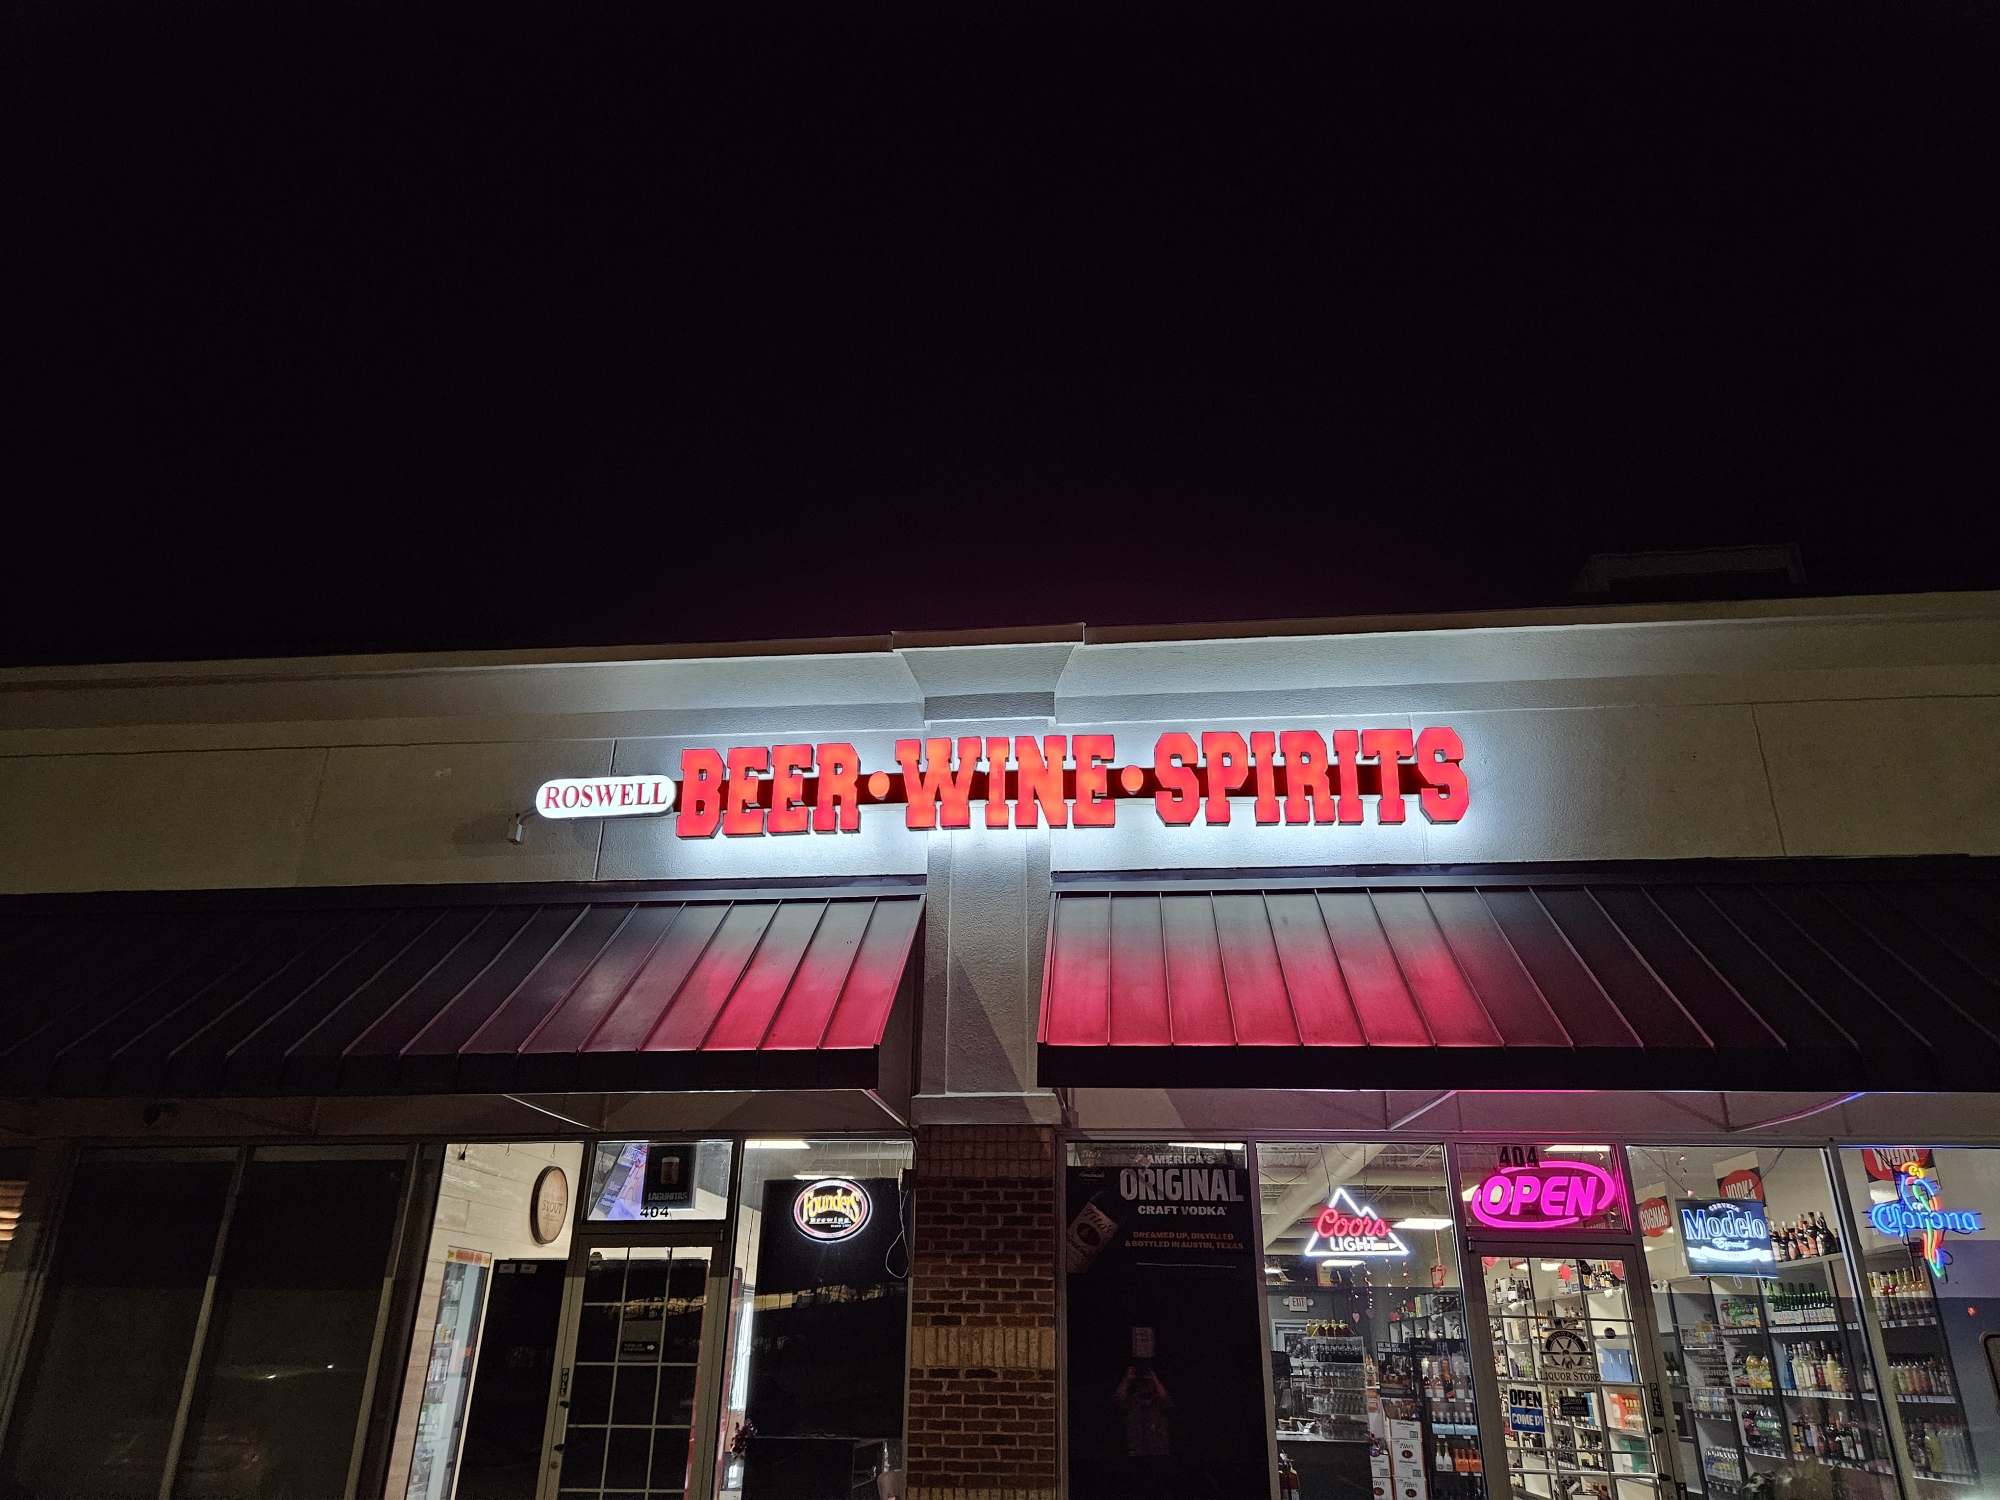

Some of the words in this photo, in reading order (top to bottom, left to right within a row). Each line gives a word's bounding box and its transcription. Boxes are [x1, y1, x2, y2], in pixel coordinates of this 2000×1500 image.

[676, 742, 860, 838] BEER
[895, 735, 1115, 831] WINE
[1154, 727, 1469, 827] SPIRITS
[543, 782, 668, 809] ROSWELL
[1147, 1154, 1216, 1165] AMERICA'S
[1499, 1145, 1539, 1168] 404
[1119, 1167, 1245, 1202] ORIGINAL
[647, 1191, 688, 1201] LAGUNITAS
[1481, 1175, 1598, 1216] OPEN
[542, 1200, 563, 1214] STOUT
[640, 1206, 669, 1218] 404
[802, 1187, 861, 1224] Founders
[1137, 1205, 1178, 1215] CRAFT
[1708, 1202, 1740, 1213] CERVEZA
[1316, 1208, 1392, 1238] Coors
[1640, 1205, 1668, 1231] COGNAC
[1681, 1208, 1767, 1240] Modelo
[1871, 1203, 1980, 1237] Corona
[1132, 1231, 1175, 1239] DREAMED
[1191, 1232, 1234, 1241] DISTILLED
[1329, 1236, 1379, 1251] LIGHT
[1292, 1297, 1305, 1307] EXIT
[561, 1368, 569, 1396] PULL
[1539, 1371, 1572, 1382] LIQUOR
[1572, 1371, 1601, 1382] STORE
[1509, 1388, 1542, 1408] OPEN
[1651, 1383, 1662, 1417] PULL
[1512, 1412, 1534, 1425] COME
[1535, 1415, 1543, 1425] IN
[1399, 1442, 1415, 1450] Tito's
[1373, 1479, 1386, 1487] ito's
